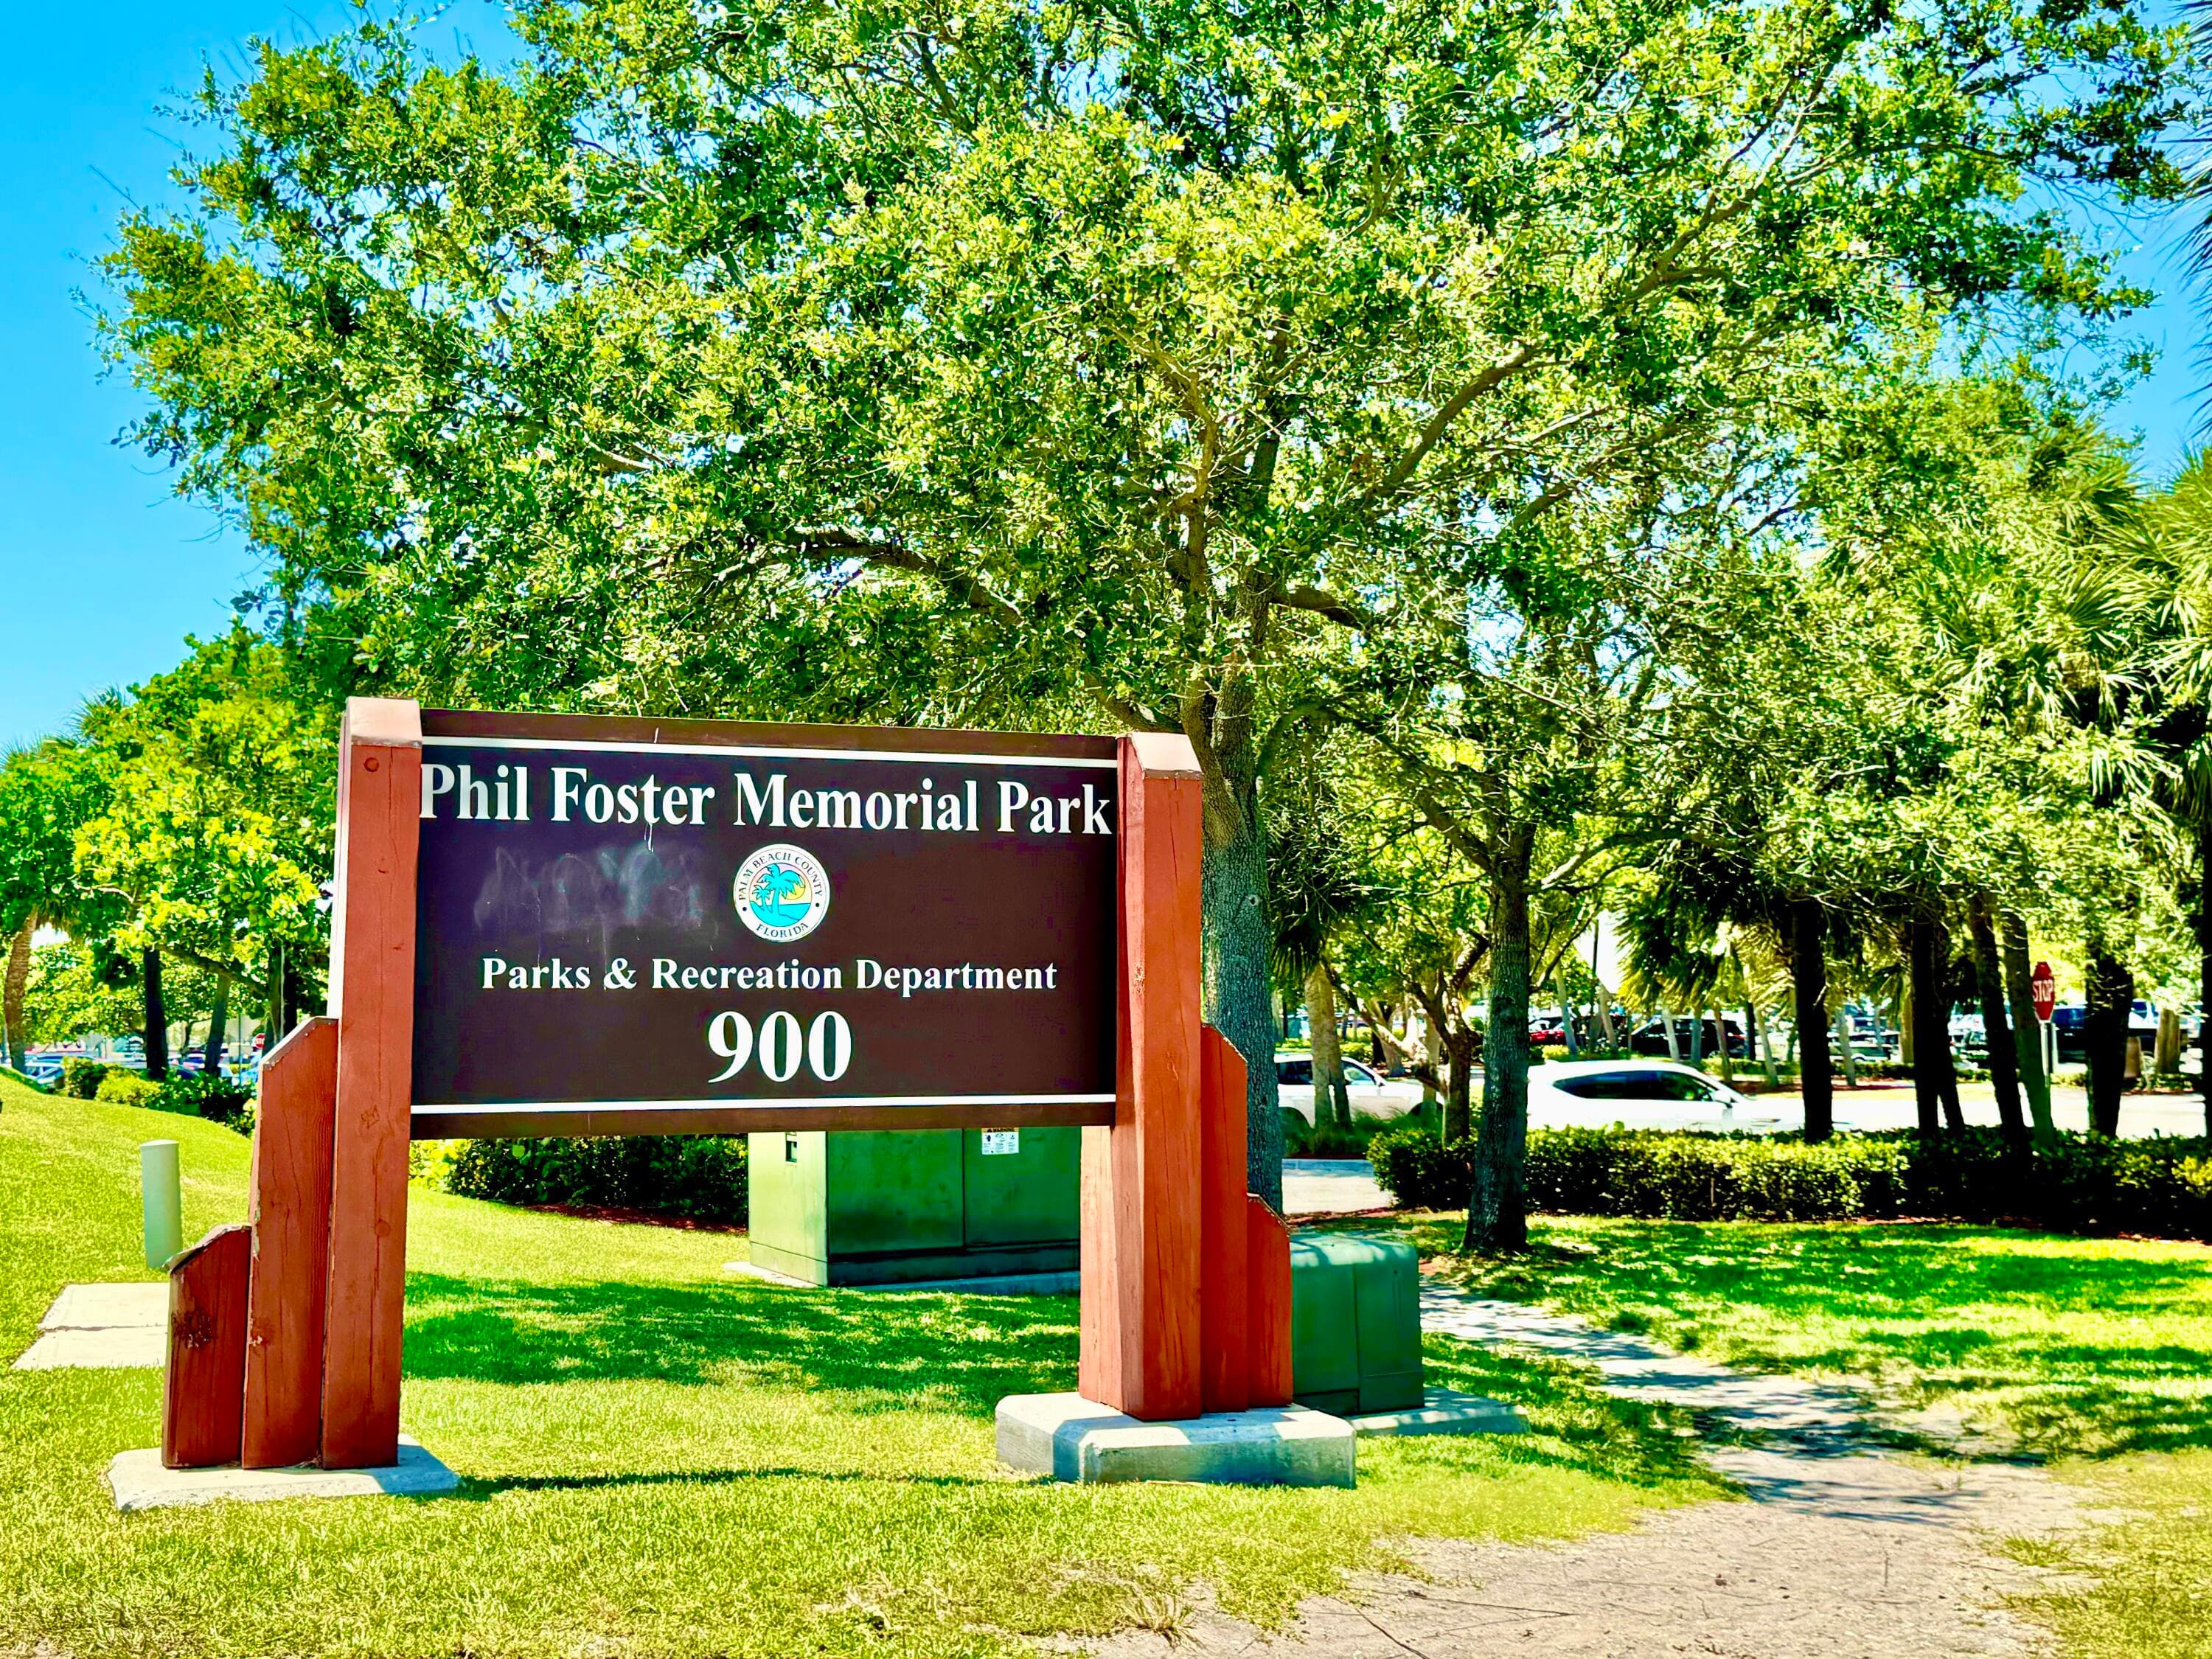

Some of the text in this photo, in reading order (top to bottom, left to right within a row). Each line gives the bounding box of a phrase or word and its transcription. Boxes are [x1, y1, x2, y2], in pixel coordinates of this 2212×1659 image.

[420, 764, 1112, 835] Phil Foster Memorial Park
[738, 852, 823, 900] PALM BEACH COUNTY
[757, 922, 809, 938] FLORIDA
[482, 958, 1057, 998] Parks & Recreation Department
[2033, 979, 2053, 1002] STOP
[708, 1011, 852, 1083] 900
